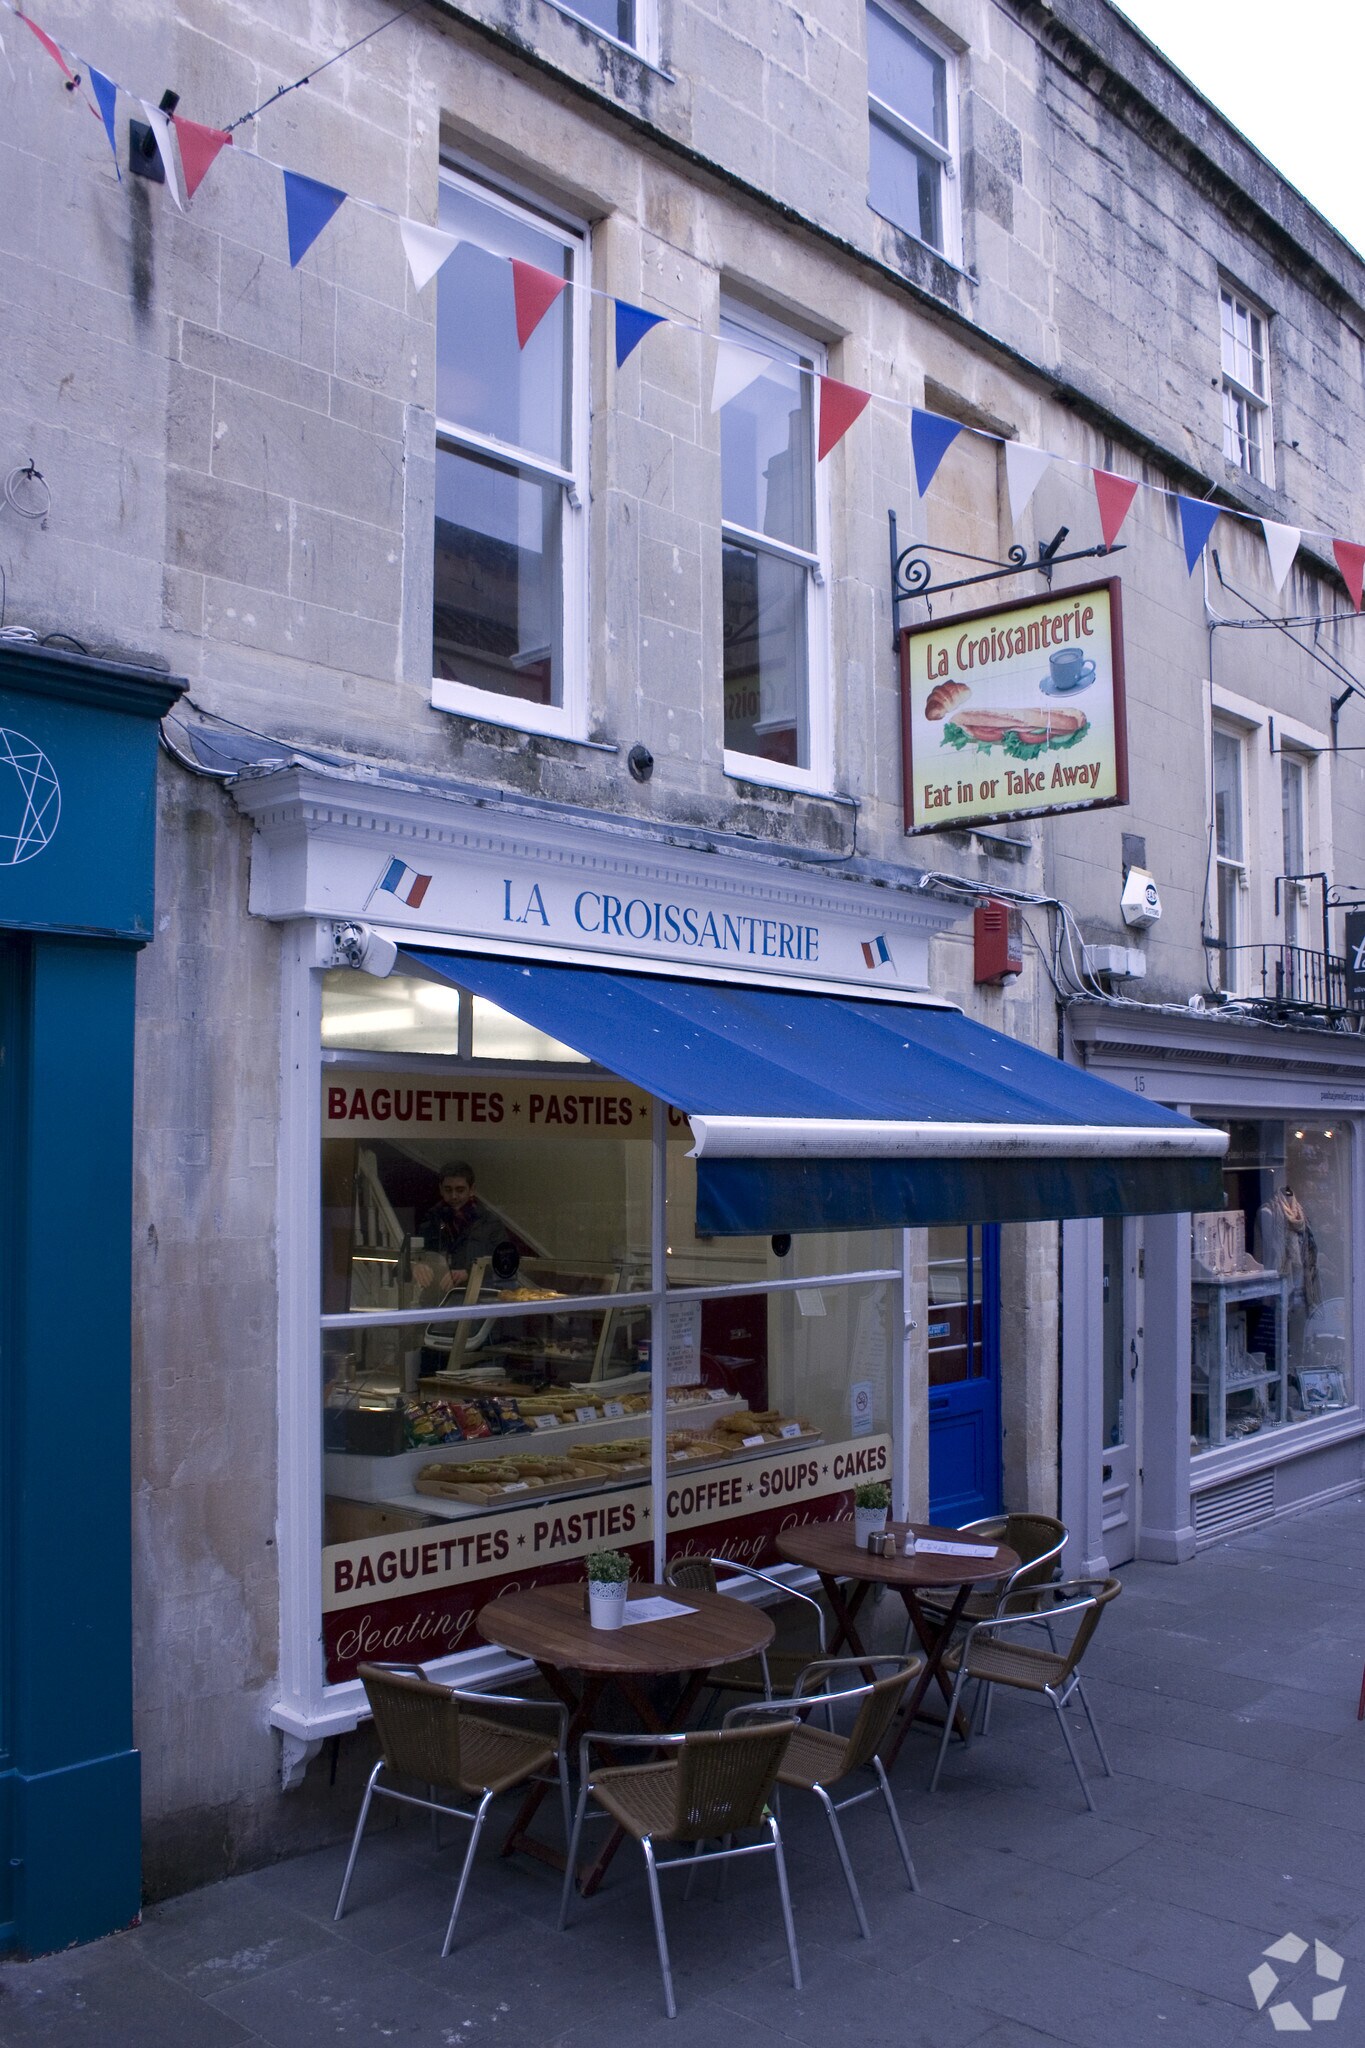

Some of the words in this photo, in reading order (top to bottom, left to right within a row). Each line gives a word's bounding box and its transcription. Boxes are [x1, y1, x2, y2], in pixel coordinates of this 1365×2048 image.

[926, 643, 949, 680] La
[957, 602, 1094, 671] Croissanterie
[924, 784, 951, 809] Eat
[957, 781, 974, 802] in
[980, 777, 999, 800] or
[1004, 768, 1045, 795] Take
[1051, 762, 1100, 788] Away
[502, 880, 550, 926] LA
[574, 891, 819, 962] CROISSANTERIE
[328, 1087, 504, 1123] BAGUETTES
[529, 1094, 633, 1126] PASTIES
[1134, 1076, 1145, 1092] 15
[334, 1529, 509, 1594] BAGUETTES
[534, 1503, 636, 1551] PASTIES
[667, 1477, 742, 1518] COFFEE
[759, 1461, 819, 1497] SOUPS
[833, 1445, 886, 1480] CAKES
[336, 1608, 477, 1662] Seating
